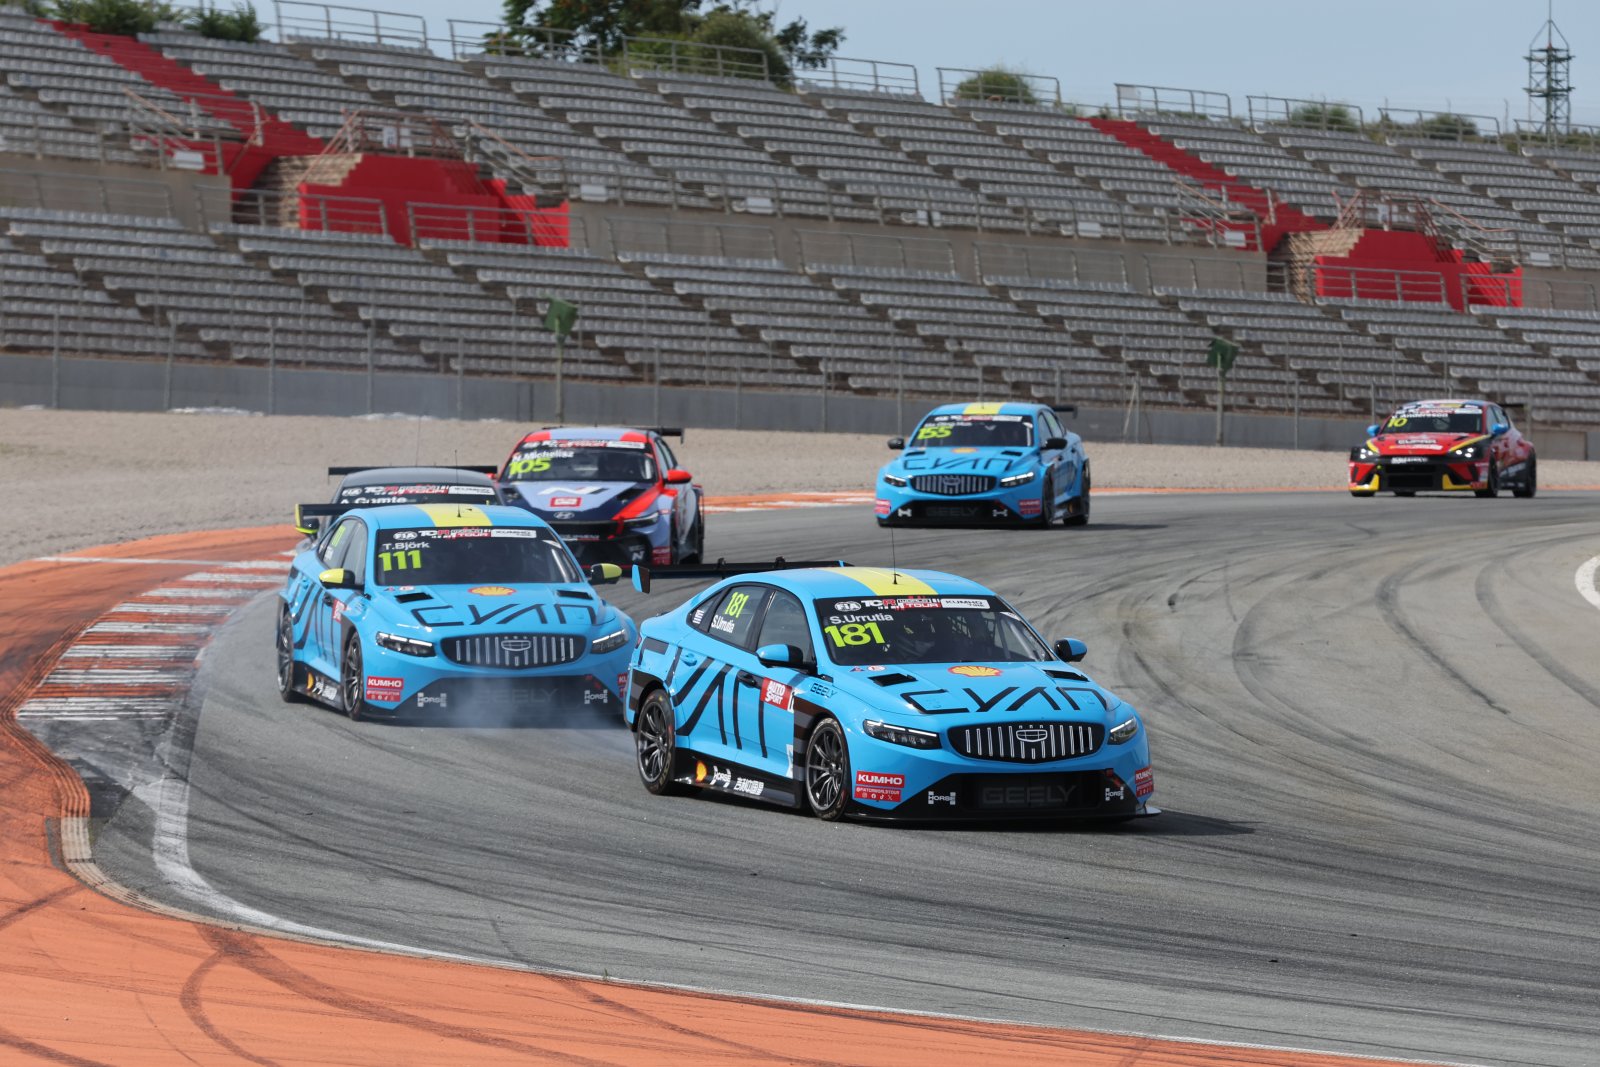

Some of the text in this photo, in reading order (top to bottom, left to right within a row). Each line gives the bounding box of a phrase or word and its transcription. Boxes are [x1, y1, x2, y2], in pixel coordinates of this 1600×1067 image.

[1388, 417, 1408, 428] 10
[917, 425, 953, 440] 155
[509, 457, 552, 475] 105
[383, 541, 431, 552] T.Björk
[378, 549, 422, 572] 111
[724, 592, 750, 619] 181
[837, 602, 860, 611] FIA
[861, 599, 896, 608] TCR
[411, 603, 597, 628] CYAN
[830, 613, 894, 625] S.Urrutia
[825, 622, 886, 648] 181
[368, 678, 402, 688] KUMHO
[767, 680, 786, 696] AUTO
[810, 682, 838, 698] GEELY
[764, 691, 783, 705] SPORT
[900, 687, 1107, 714] CYAN
[858, 773, 902, 786] KUMHO
[982, 785, 1077, 804] GEELY
